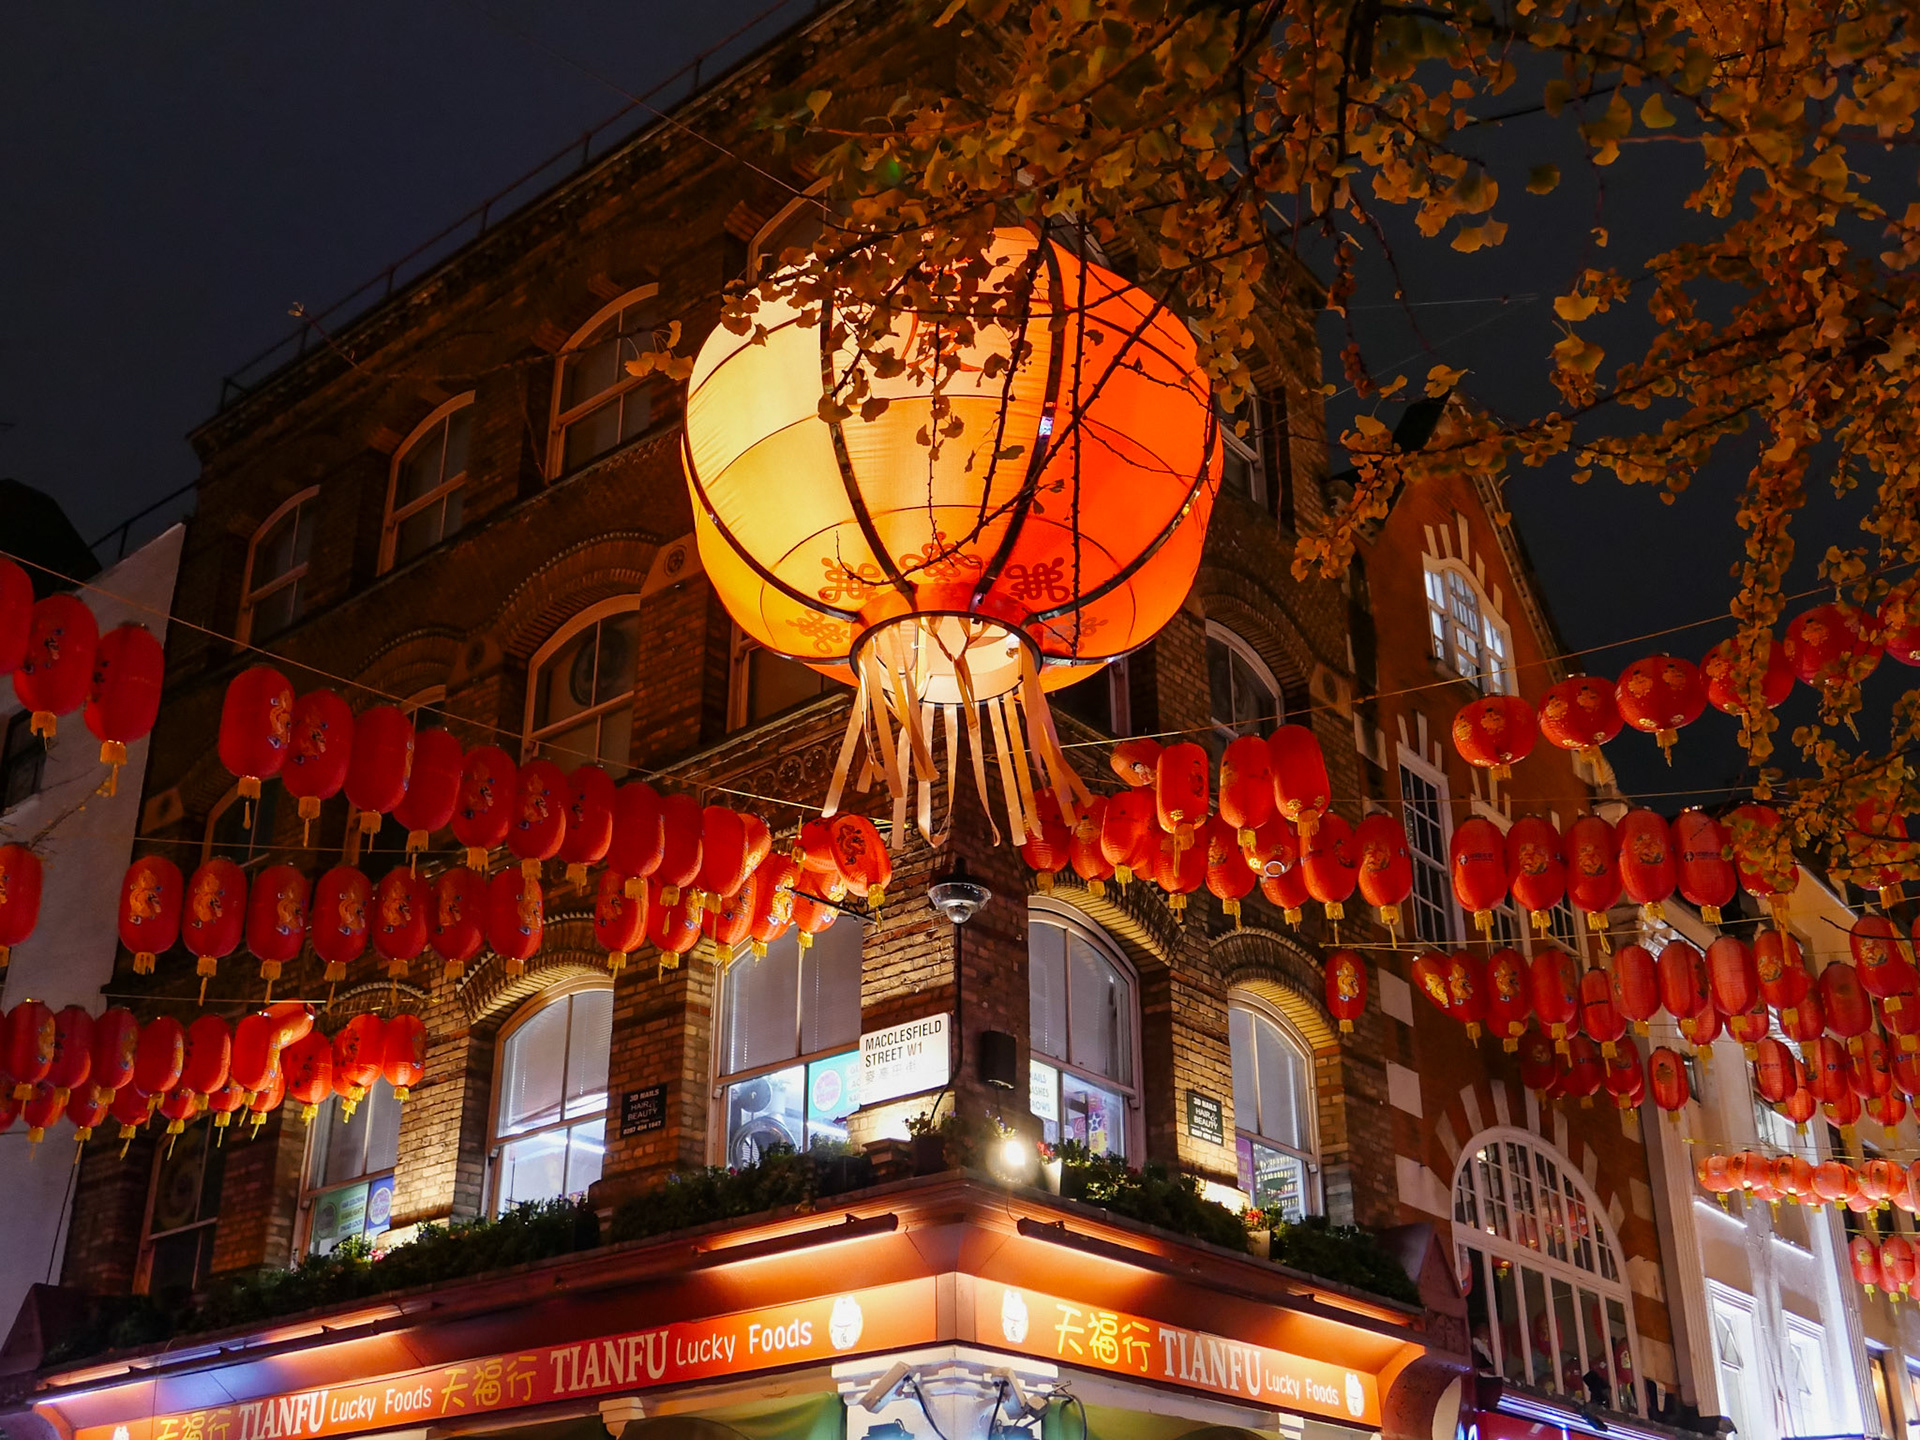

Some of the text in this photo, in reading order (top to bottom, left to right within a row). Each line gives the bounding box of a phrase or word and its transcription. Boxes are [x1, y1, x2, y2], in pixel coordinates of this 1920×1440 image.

[866, 1020, 942, 1051] MACCLESFIELD
[866, 1042, 922, 1067] STREET W1
[640, 1089, 659, 1099] NAILS
[628, 1108, 658, 1121] BEAUTY
[631, 1101, 649, 1110] HAIR
[1195, 1107, 1210, 1118] HAIR
[1194, 1116, 1218, 1130] BEAUTY
[1054, 1304, 1340, 1405] 天福行 TIANFU Lucky Foods
[440, 1318, 812, 1414] 天福行 TIANFU Lucky Foods
[239, 1391, 329, 1440] TIANFU
[331, 1397, 375, 1424] Lucky
[384, 1384, 432, 1415] Foods
